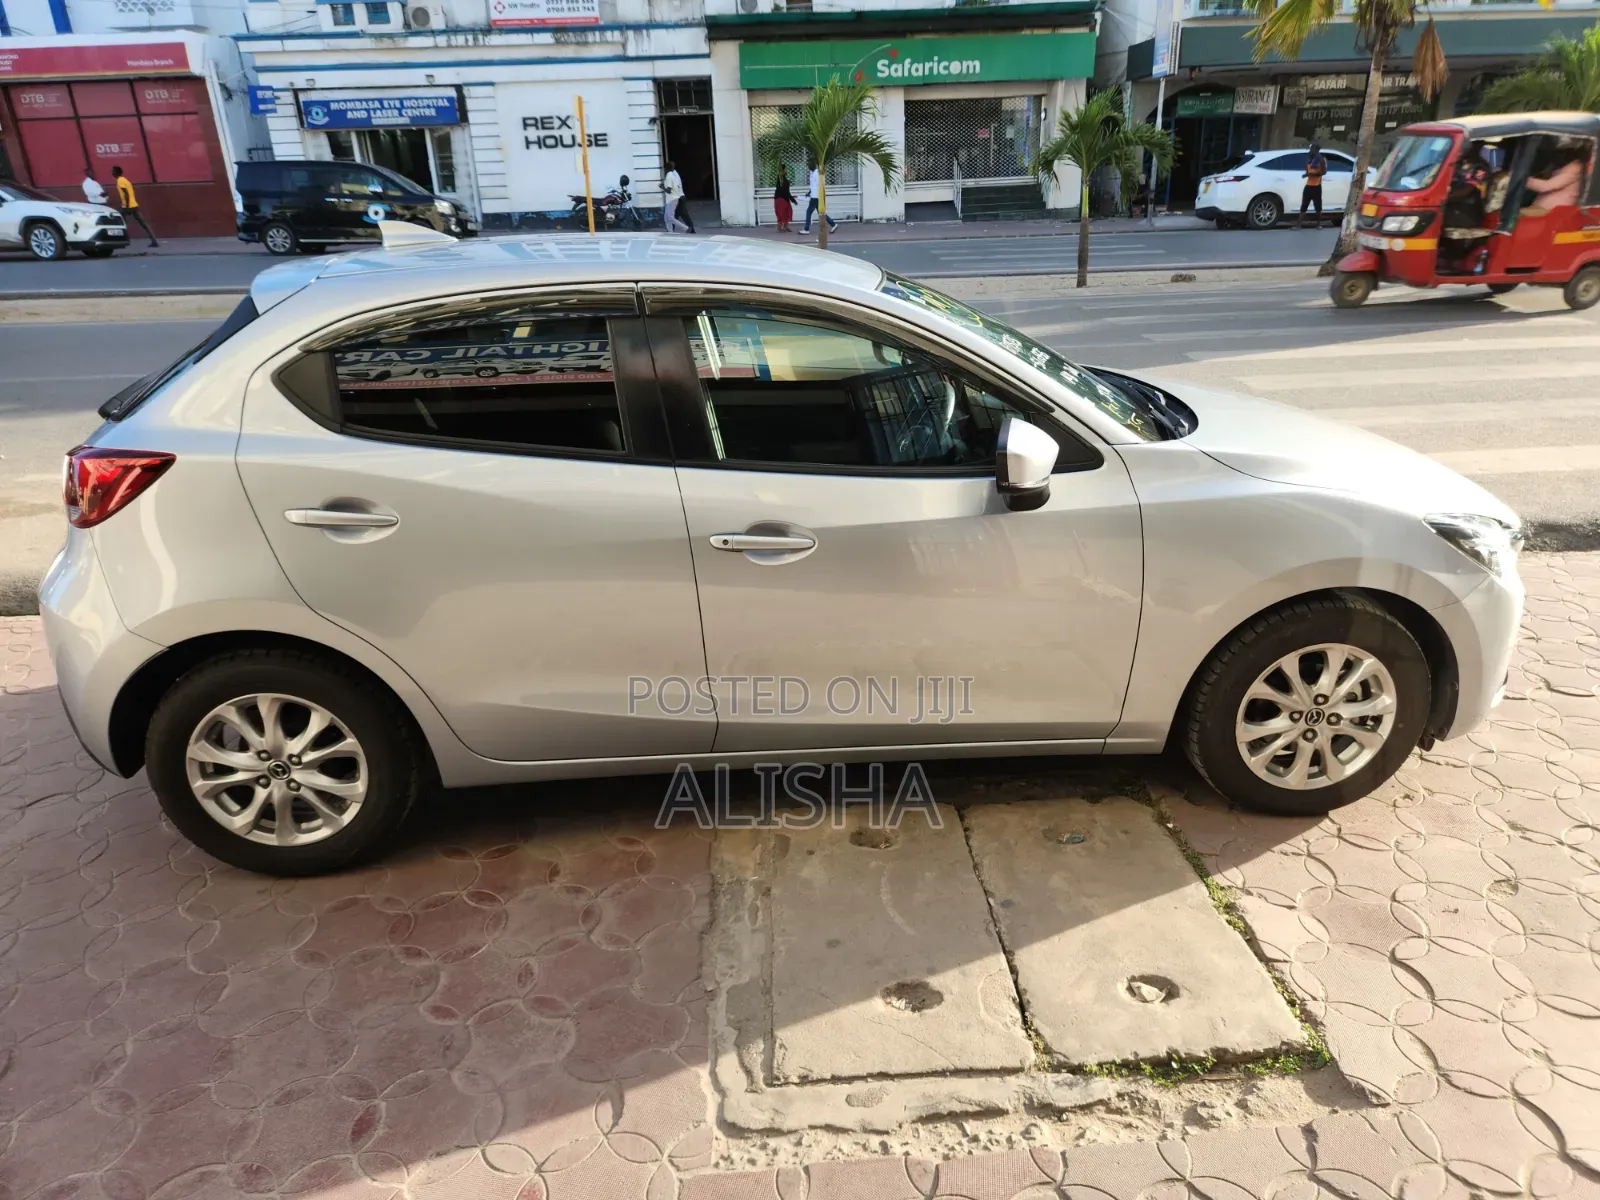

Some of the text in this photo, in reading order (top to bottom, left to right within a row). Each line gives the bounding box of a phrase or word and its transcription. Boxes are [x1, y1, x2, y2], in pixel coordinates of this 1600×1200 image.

[876, 56, 981, 78] Safaricom
[1313, 79, 1347, 90] SAFARI
[20, 93, 45, 104] DTB
[144, 89, 169, 100] DTB
[1235, 89, 1271, 103] NSURANCE
[330, 98, 450, 111] MOMBASA EYE HOSPITAL
[346, 107, 437, 119] AND LASER CENTRE
[1302, 107, 1354, 120] KETTY TOURS
[522, 115, 573, 131] REX
[524, 132, 609, 150] HOUSE
[96, 143, 119, 153] DTB
